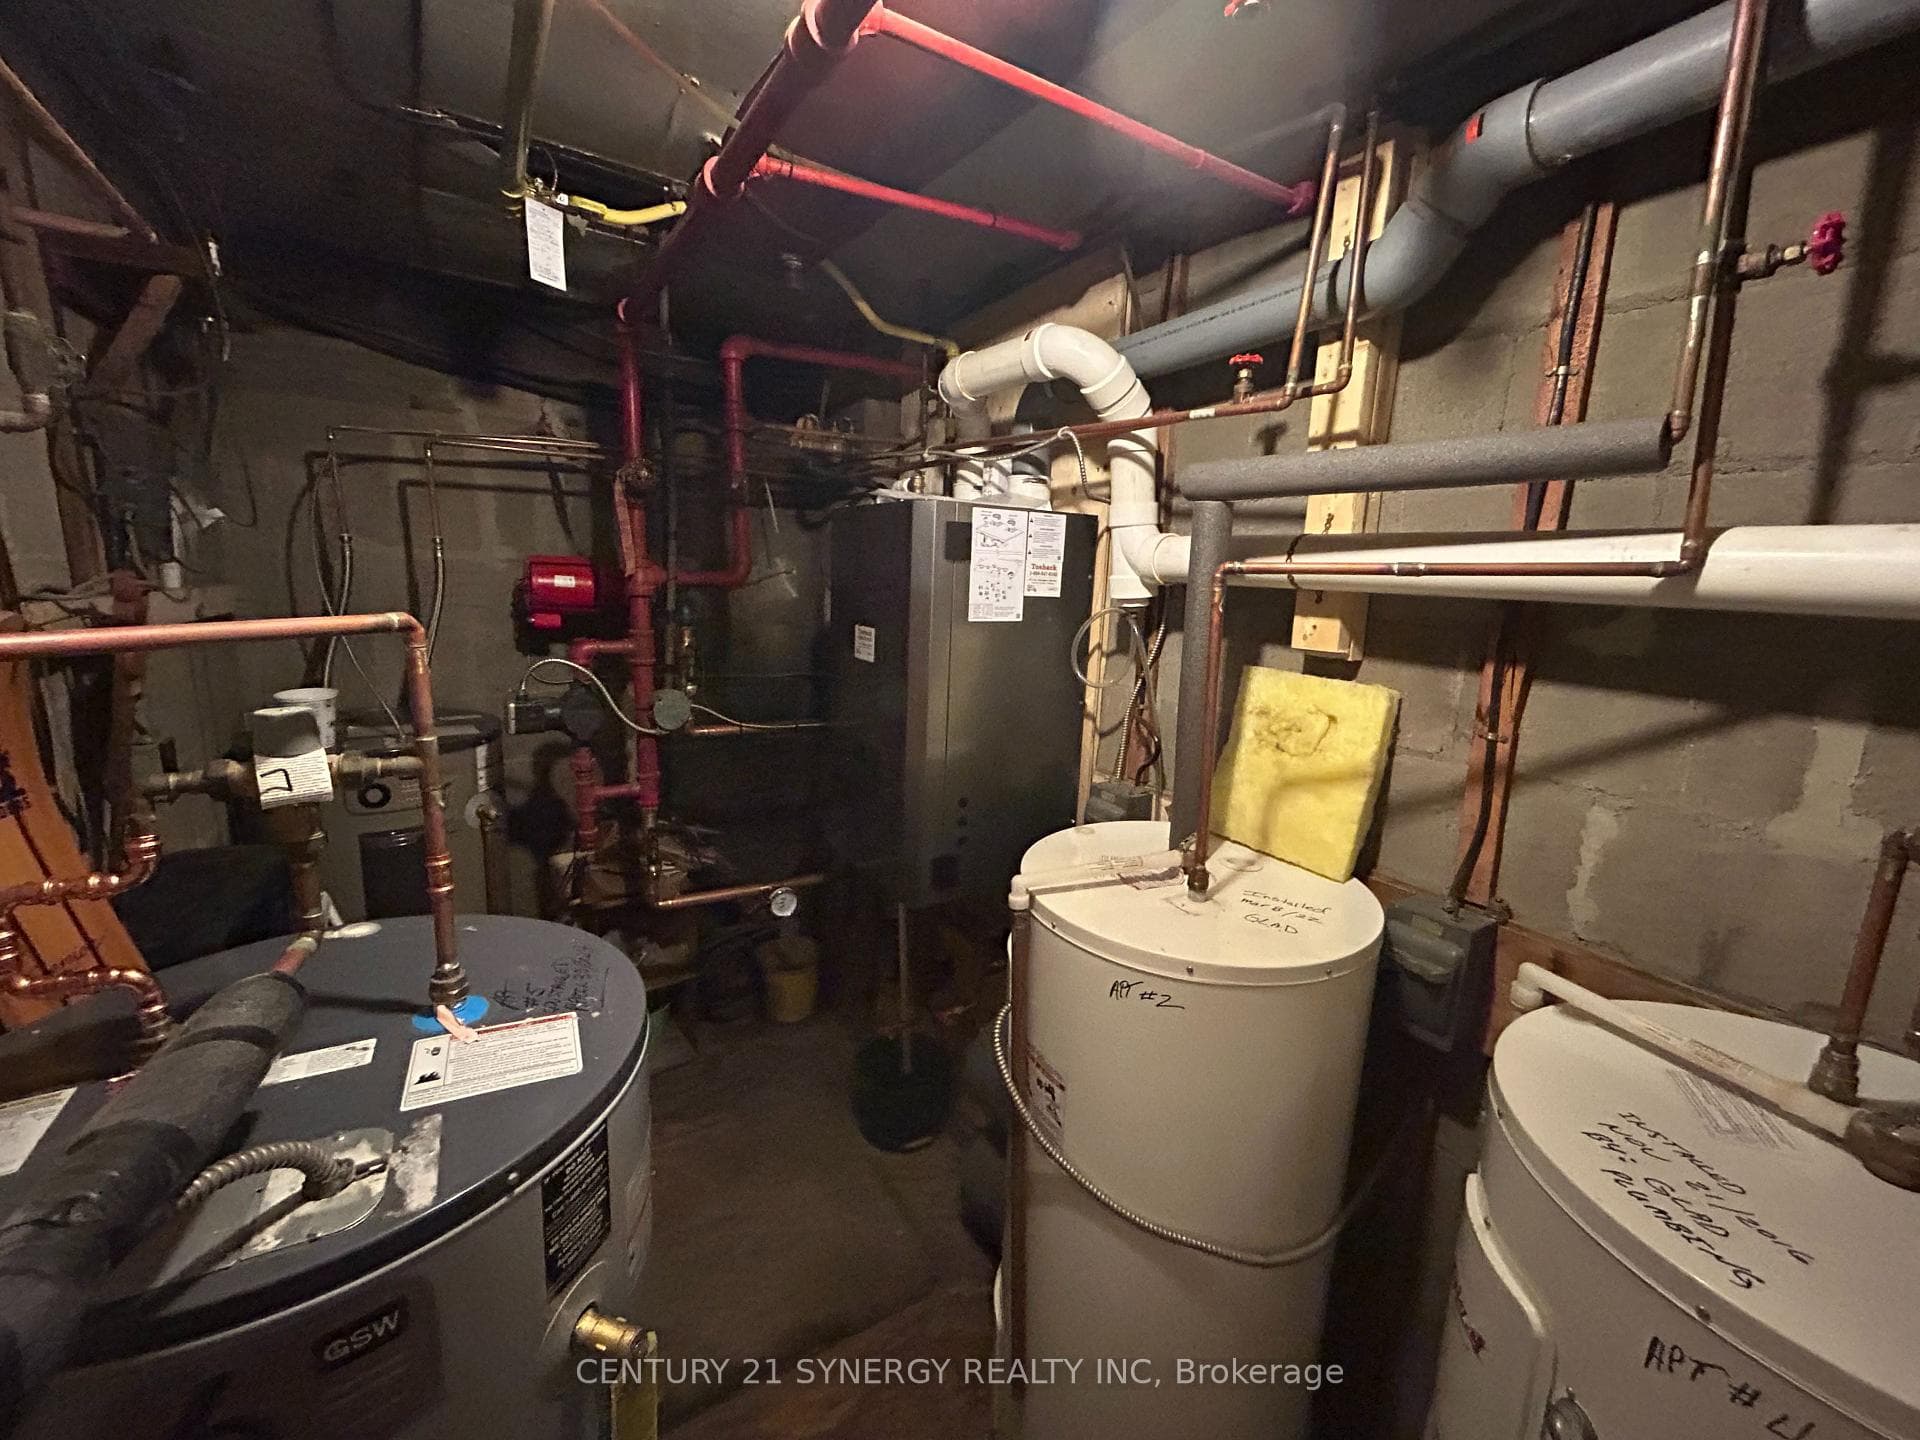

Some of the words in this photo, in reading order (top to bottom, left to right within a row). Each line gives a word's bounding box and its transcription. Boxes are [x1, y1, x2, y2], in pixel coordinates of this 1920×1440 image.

[1619, 1112, 1746, 1195] INSTALLED
[1600, 1168, 1766, 1289] PLUMBING
[1644, 1177, 1730, 1238] GLAD
[323, 1310, 399, 1361] GSW
